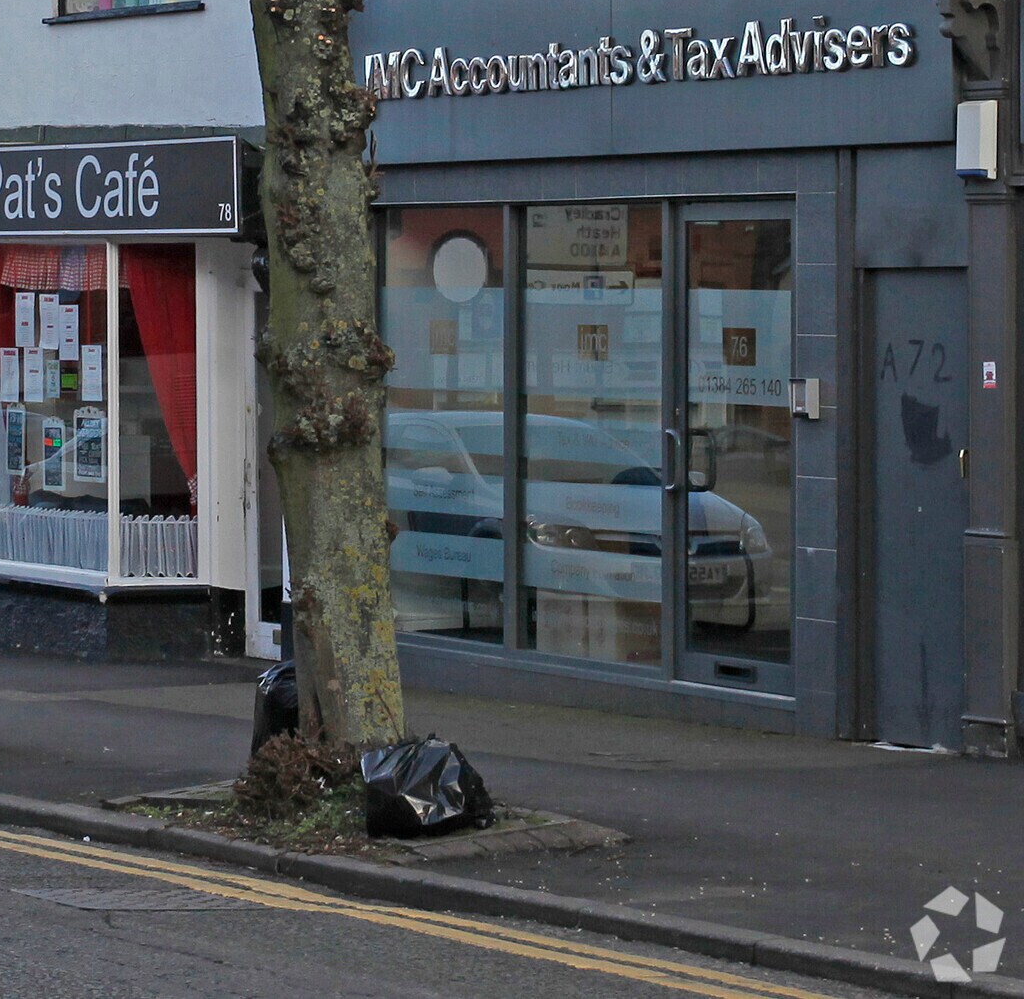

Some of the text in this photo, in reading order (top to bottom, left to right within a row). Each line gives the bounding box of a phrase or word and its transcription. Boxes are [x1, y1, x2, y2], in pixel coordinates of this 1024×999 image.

[427, 36, 632, 97] Accountants
[636, 29, 666, 84] &
[665, 28, 736, 81] Tax
[736, 15, 918, 77] Advisers
[76, 153, 160, 219] Café
[218, 203, 232, 221] 78
[731, 336, 748, 357] 76
[698, 376, 782, 396] 01384 265 140
